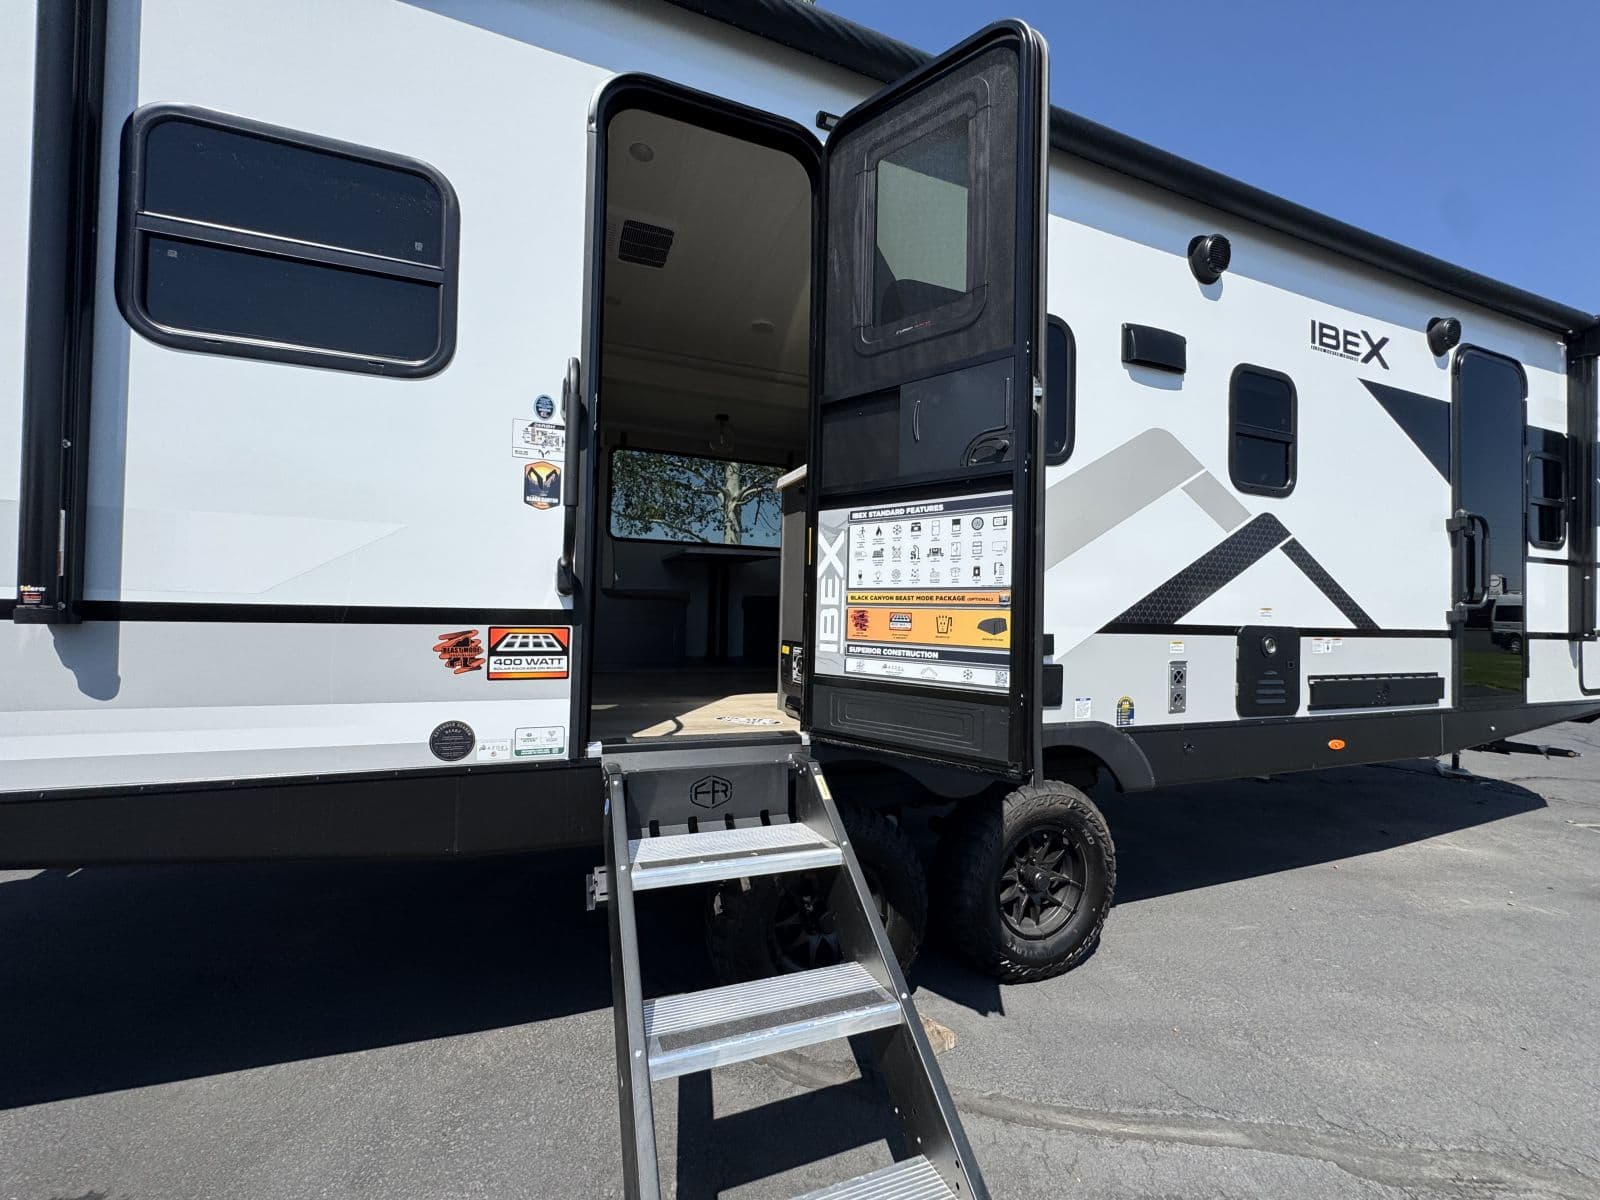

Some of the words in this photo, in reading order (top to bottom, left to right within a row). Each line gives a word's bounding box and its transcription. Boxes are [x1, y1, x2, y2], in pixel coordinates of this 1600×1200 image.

[1310, 318, 1390, 371] IBEX
[868, 508, 905, 518] STANDARD
[906, 504, 944, 514] FEATURES
[817, 529, 845, 653] IBEX
[849, 646, 881, 655] SUPERIOR
[882, 649, 939, 659] CONSTRUCTION
[493, 658, 523, 666] 400
[525, 658, 564, 666] WATT
